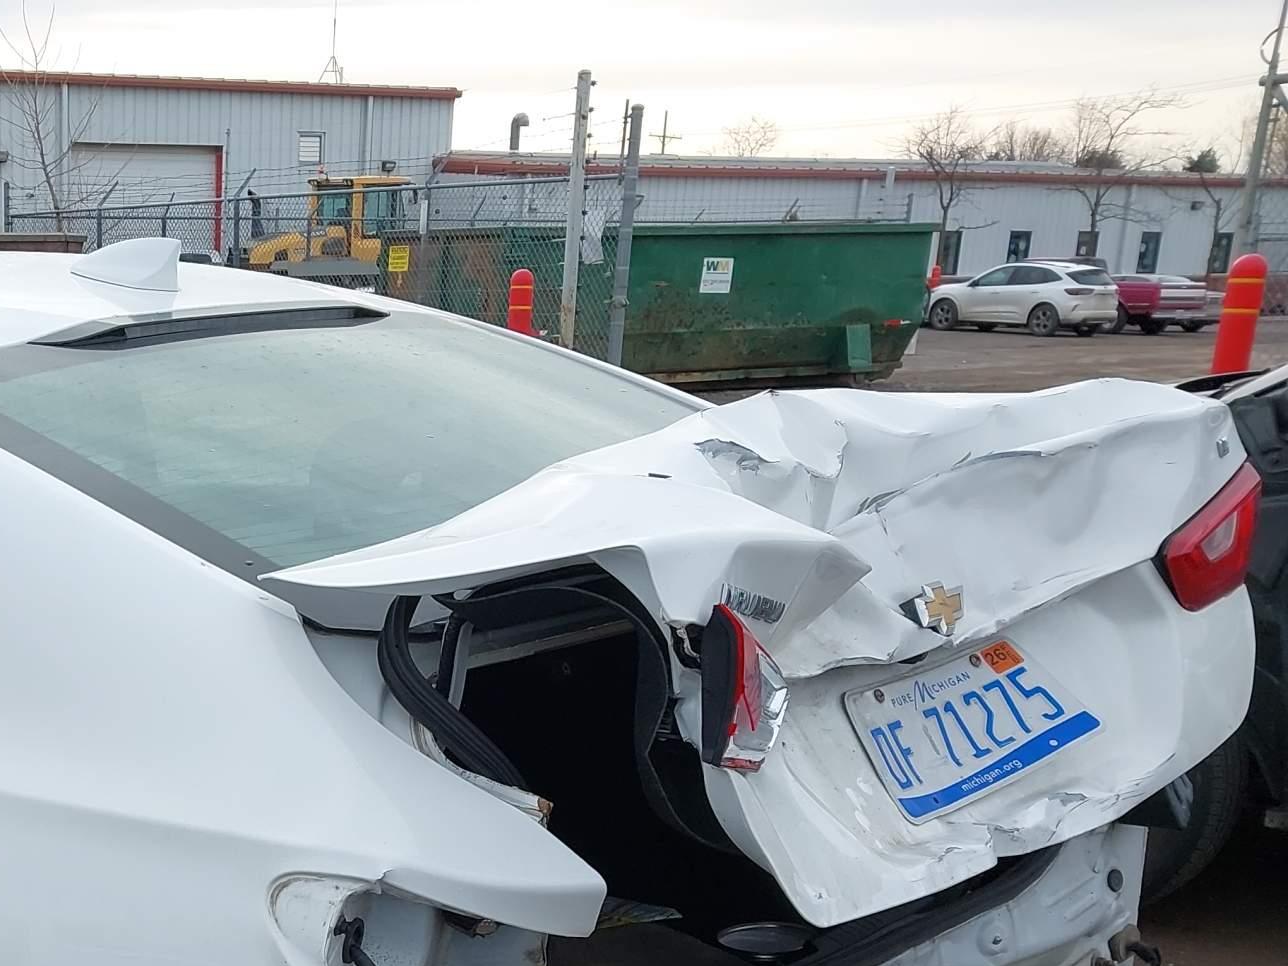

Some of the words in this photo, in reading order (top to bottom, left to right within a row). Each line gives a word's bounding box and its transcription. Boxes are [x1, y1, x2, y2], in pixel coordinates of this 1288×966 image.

[706, 260, 729, 271] WM
[984, 648, 1007, 665] 26
[890, 693, 914, 708] PURE
[913, 671, 971, 711] MICHIGAN
[922, 666, 1065, 767] 71275
[961, 759, 1023, 792] michigan.org
